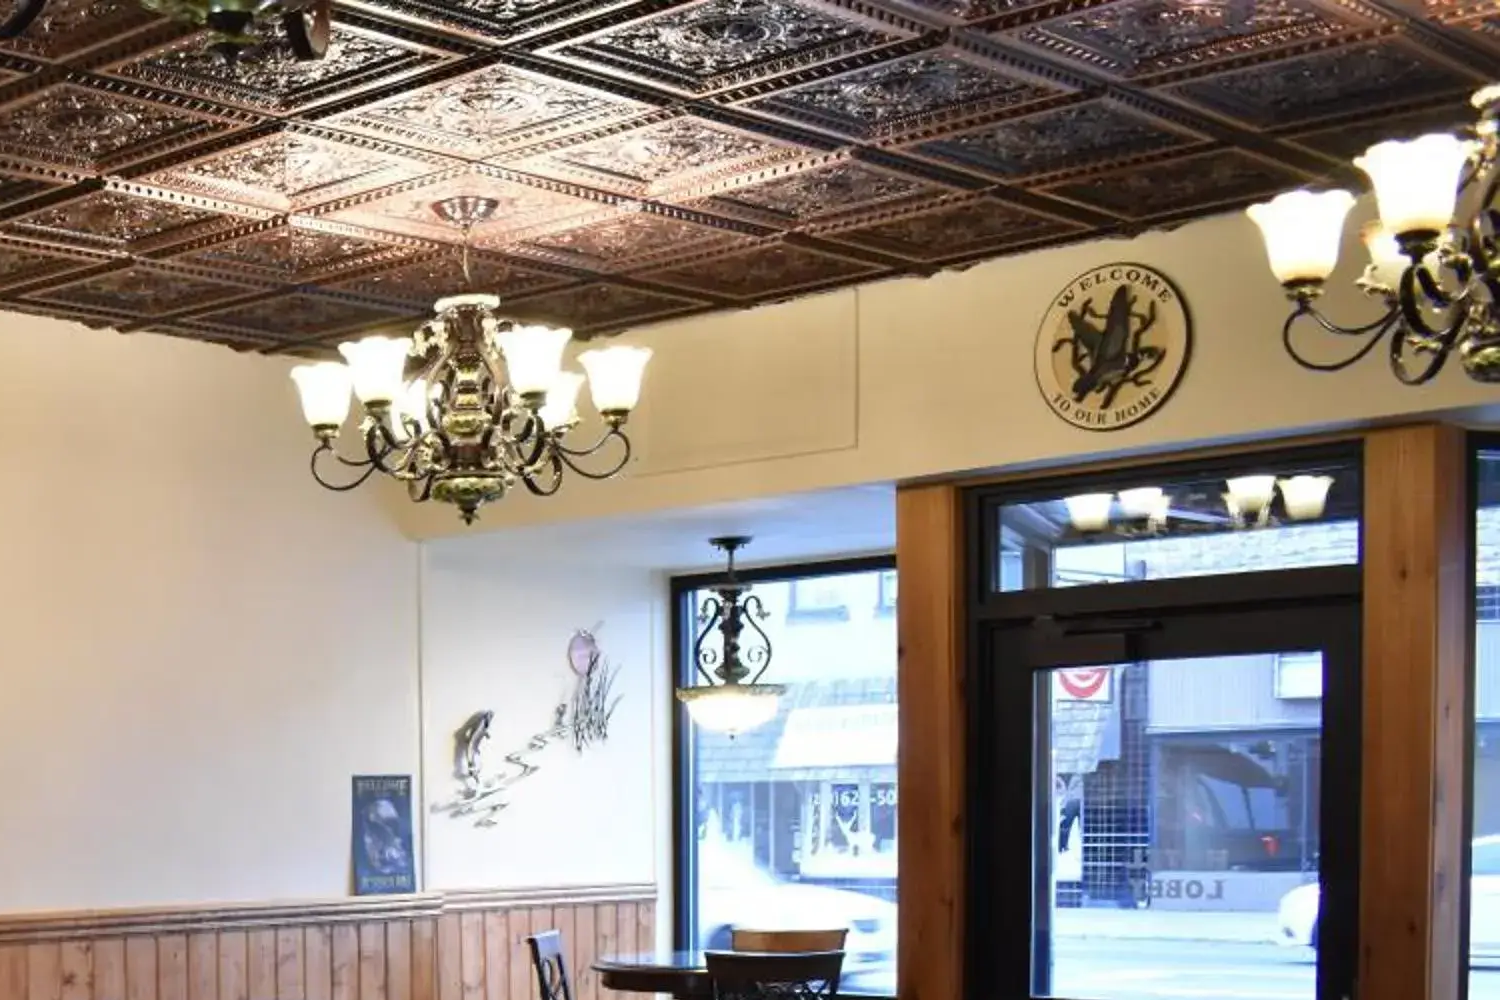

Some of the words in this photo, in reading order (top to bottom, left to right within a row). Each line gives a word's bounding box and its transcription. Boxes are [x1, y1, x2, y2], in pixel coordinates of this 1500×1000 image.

[1058, 269, 1172, 308] WELCOME
[1053, 394, 1071, 412] TO
[1075, 409, 1107, 424] OUR
[1115, 388, 1159, 423] HOME
